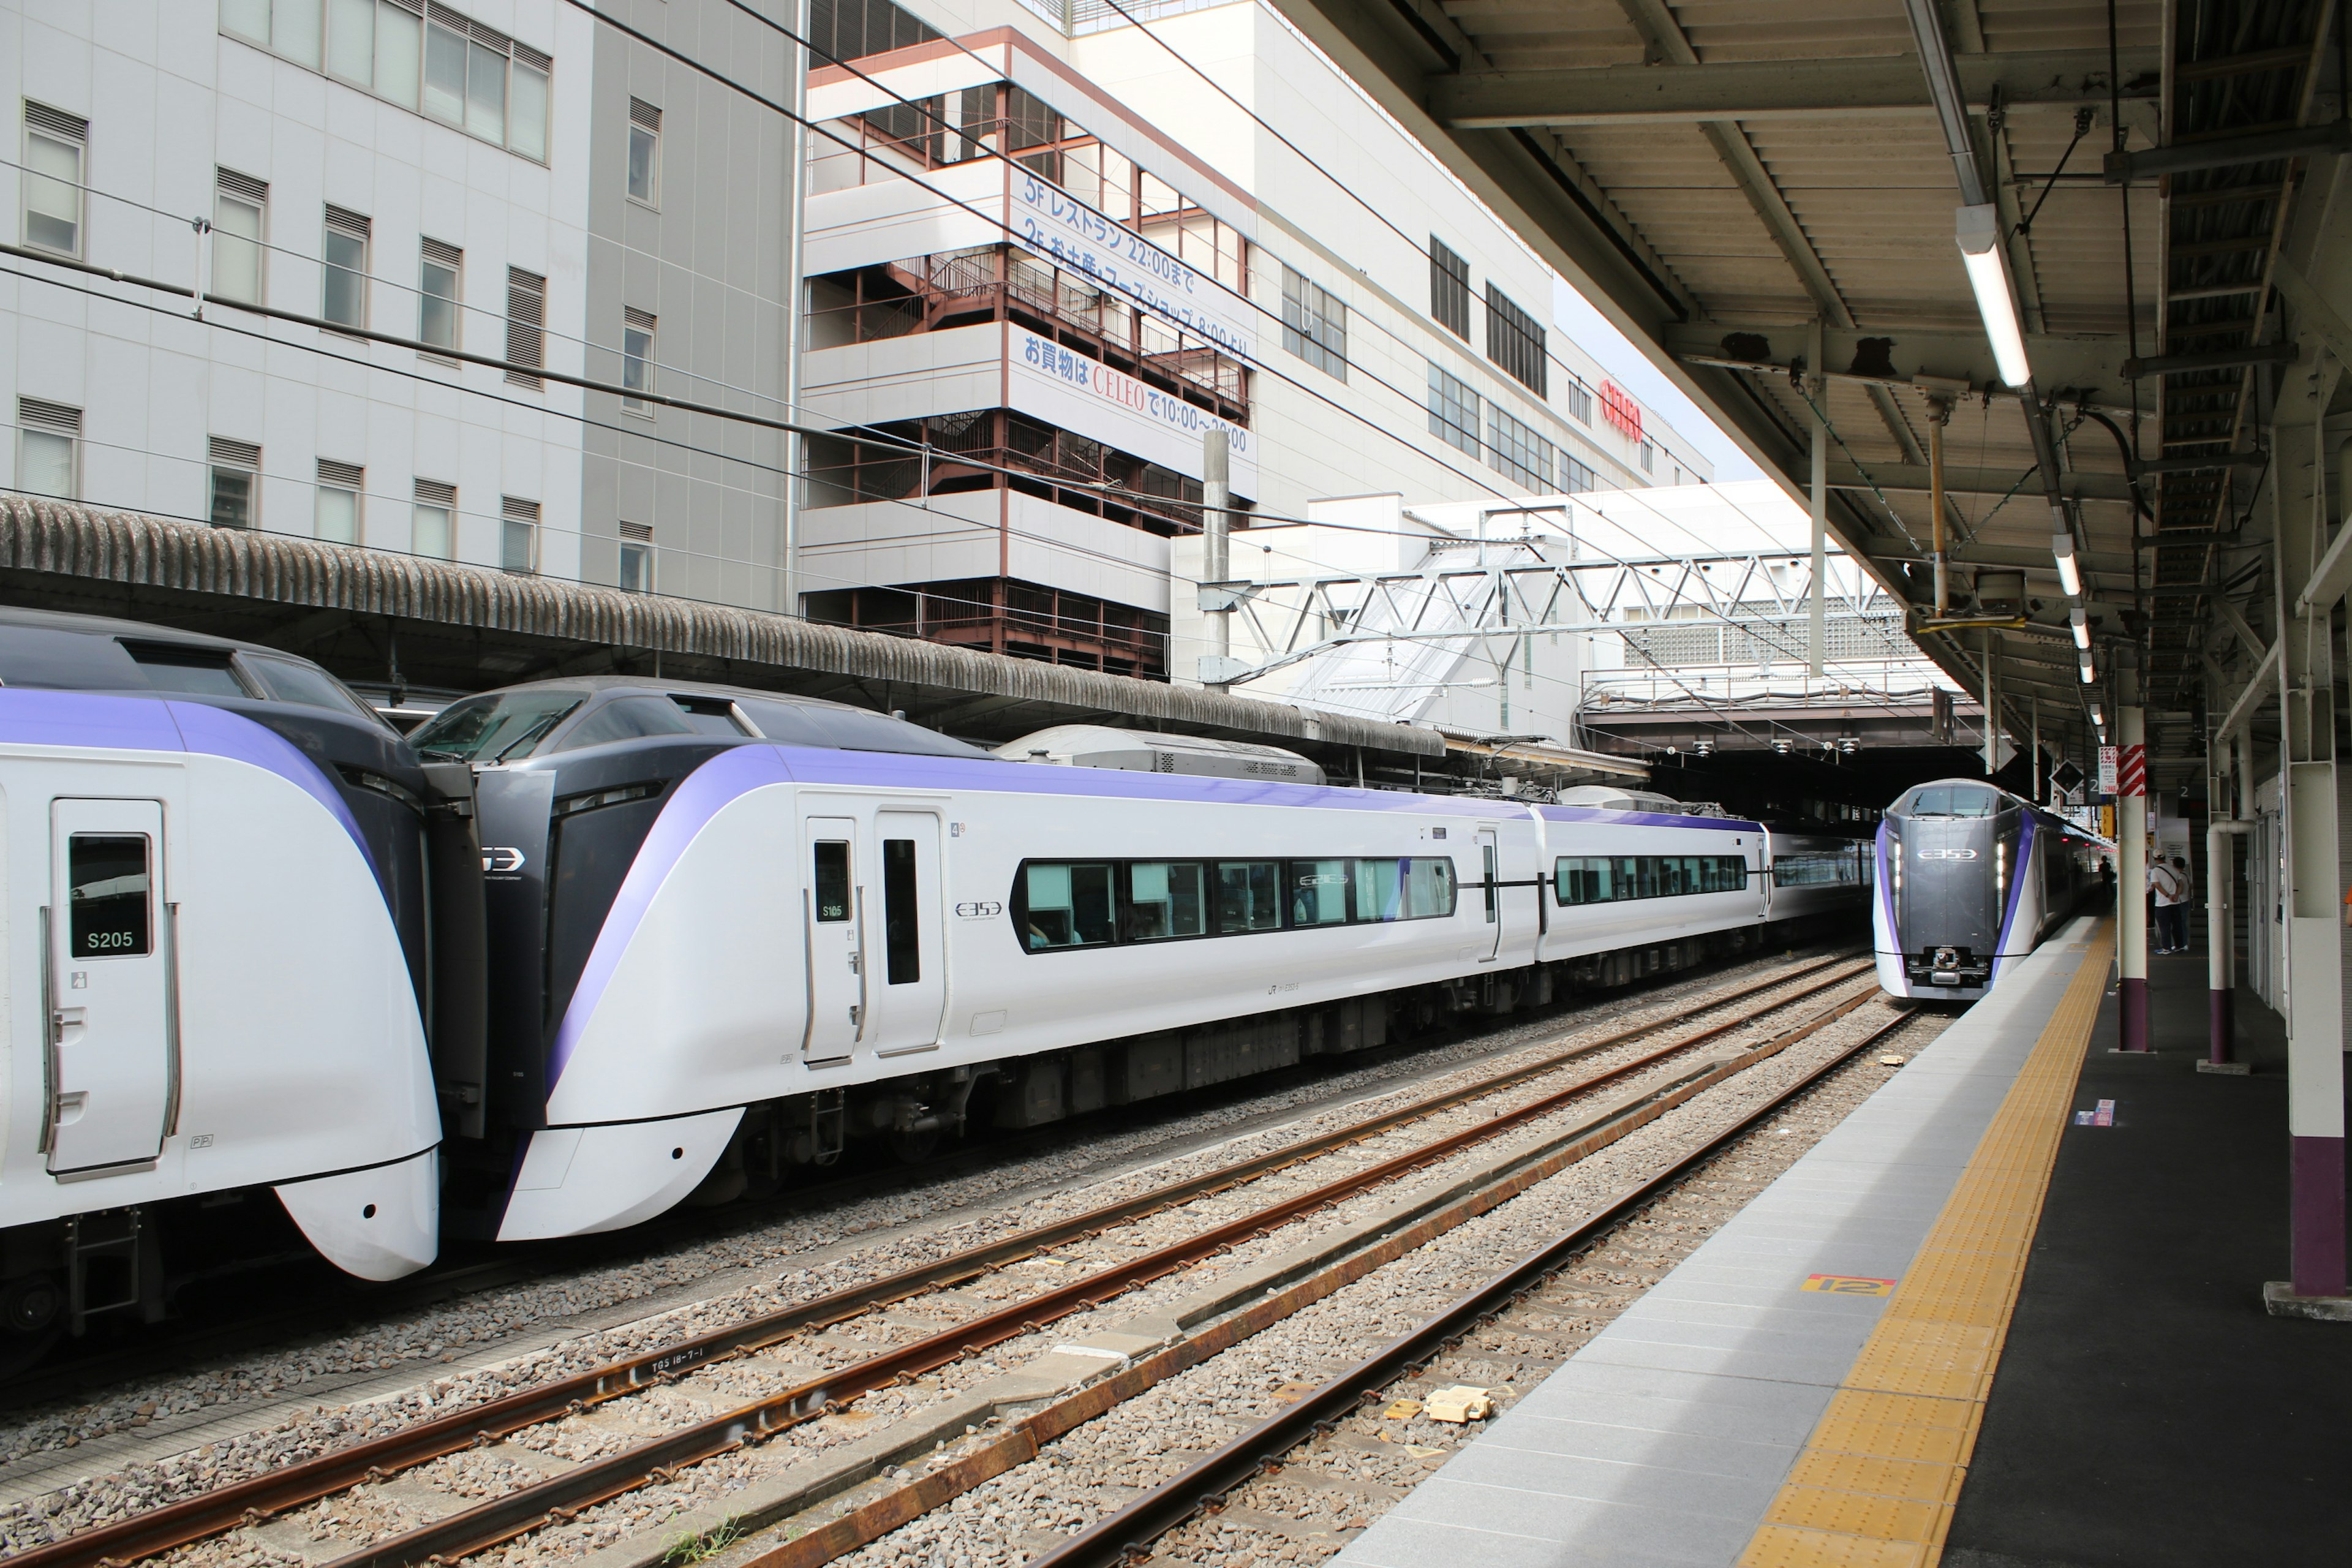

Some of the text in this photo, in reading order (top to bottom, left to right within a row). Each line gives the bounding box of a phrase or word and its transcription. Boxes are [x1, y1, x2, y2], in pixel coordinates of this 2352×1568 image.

[1025, 175, 1194, 294] 5F レストラン 22:00まで
[1025, 218, 1044, 254] 2F
[1199, 317, 1247, 361] 8:00より
[1025, 337, 1088, 385] お買物は
[1093, 366, 1145, 412] CELEO
[2090, 779, 2099, 791] 2
[2180, 786, 2188, 797] 2
[952, 824, 958, 835] 4
[1917, 849, 1977, 859] E353
[823, 905, 842, 916] S105
[956, 902, 1001, 916] E353
[88, 932, 133, 948] S205
[1268, 985, 1276, 995] JR
[1819, 1279, 1882, 1294] 12
[673, 1348, 703, 1365] 18-7-1
